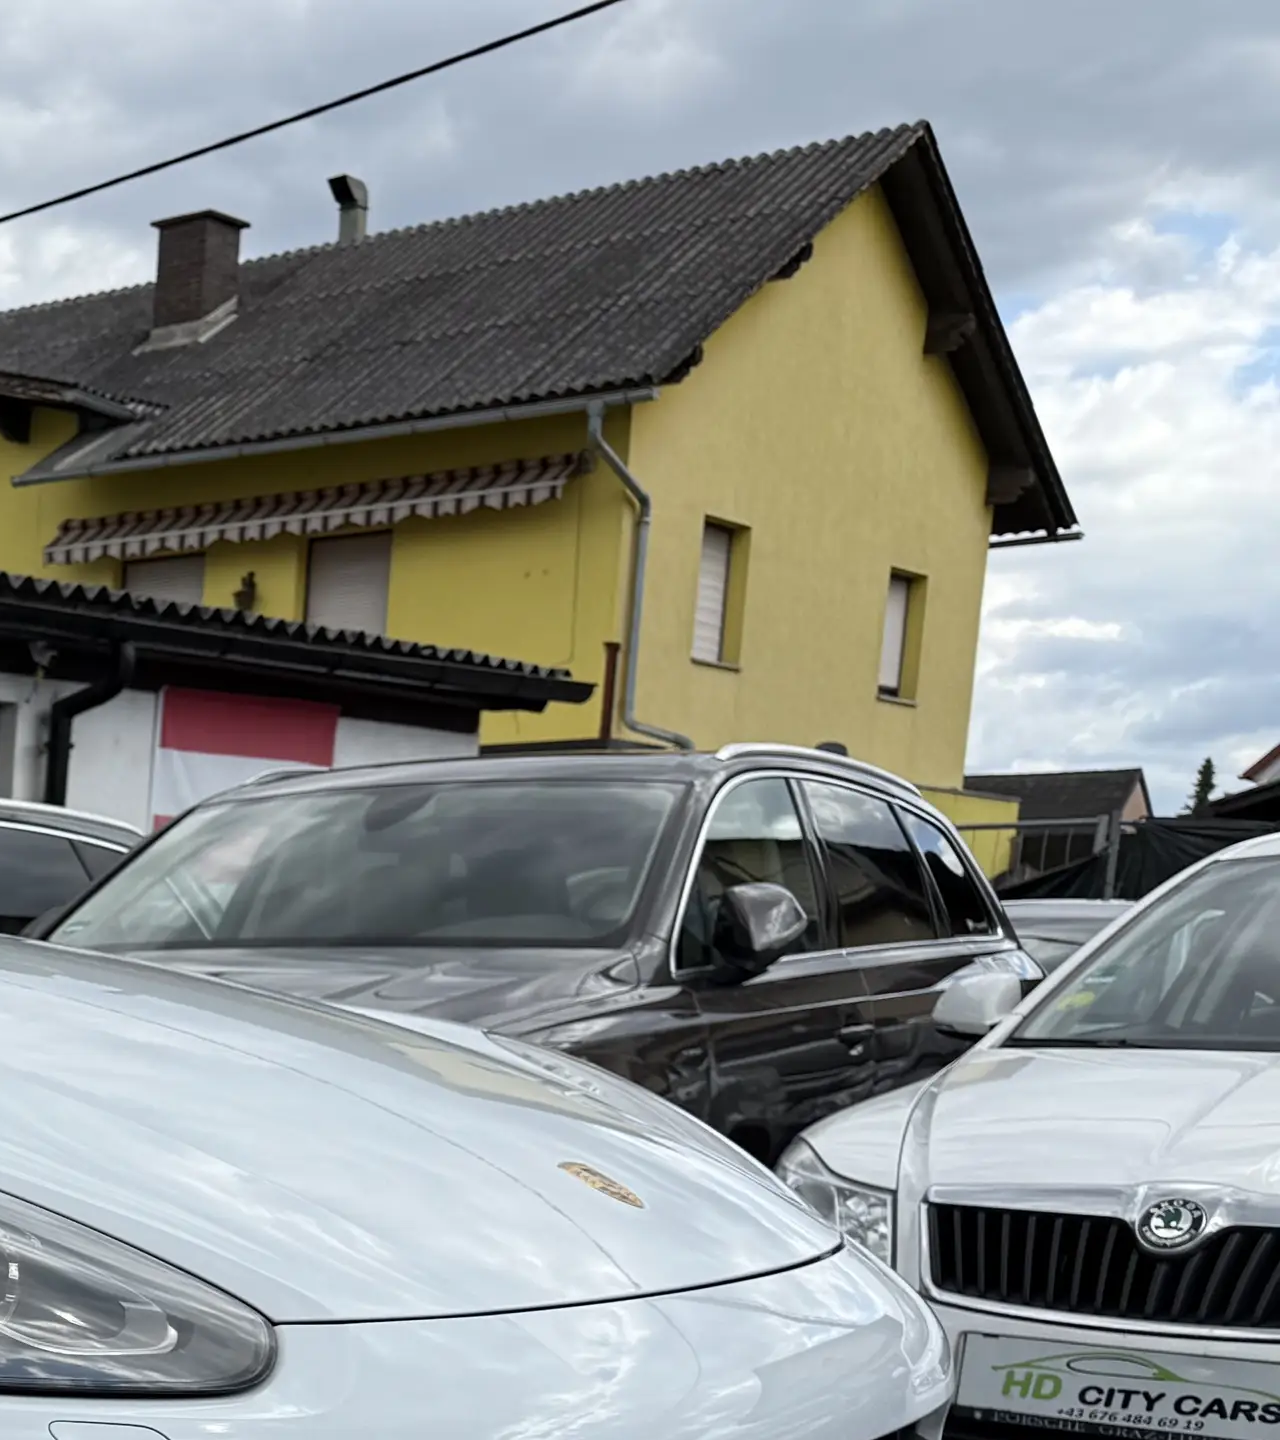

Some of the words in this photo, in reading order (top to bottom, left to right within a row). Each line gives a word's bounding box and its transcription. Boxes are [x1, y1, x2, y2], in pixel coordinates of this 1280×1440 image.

[1001, 1369, 1063, 1400] HD
[1078, 1385, 1167, 1413] CITY
[1173, 1394, 1280, 1424] CARS
[1057, 1407, 1085, 1419] +43
[1088, 1409, 1119, 1423] 676
[1122, 1413, 1153, 1426] 484
[1157, 1417, 1179, 1429] 69
[1182, 1419, 1205, 1431] 19
